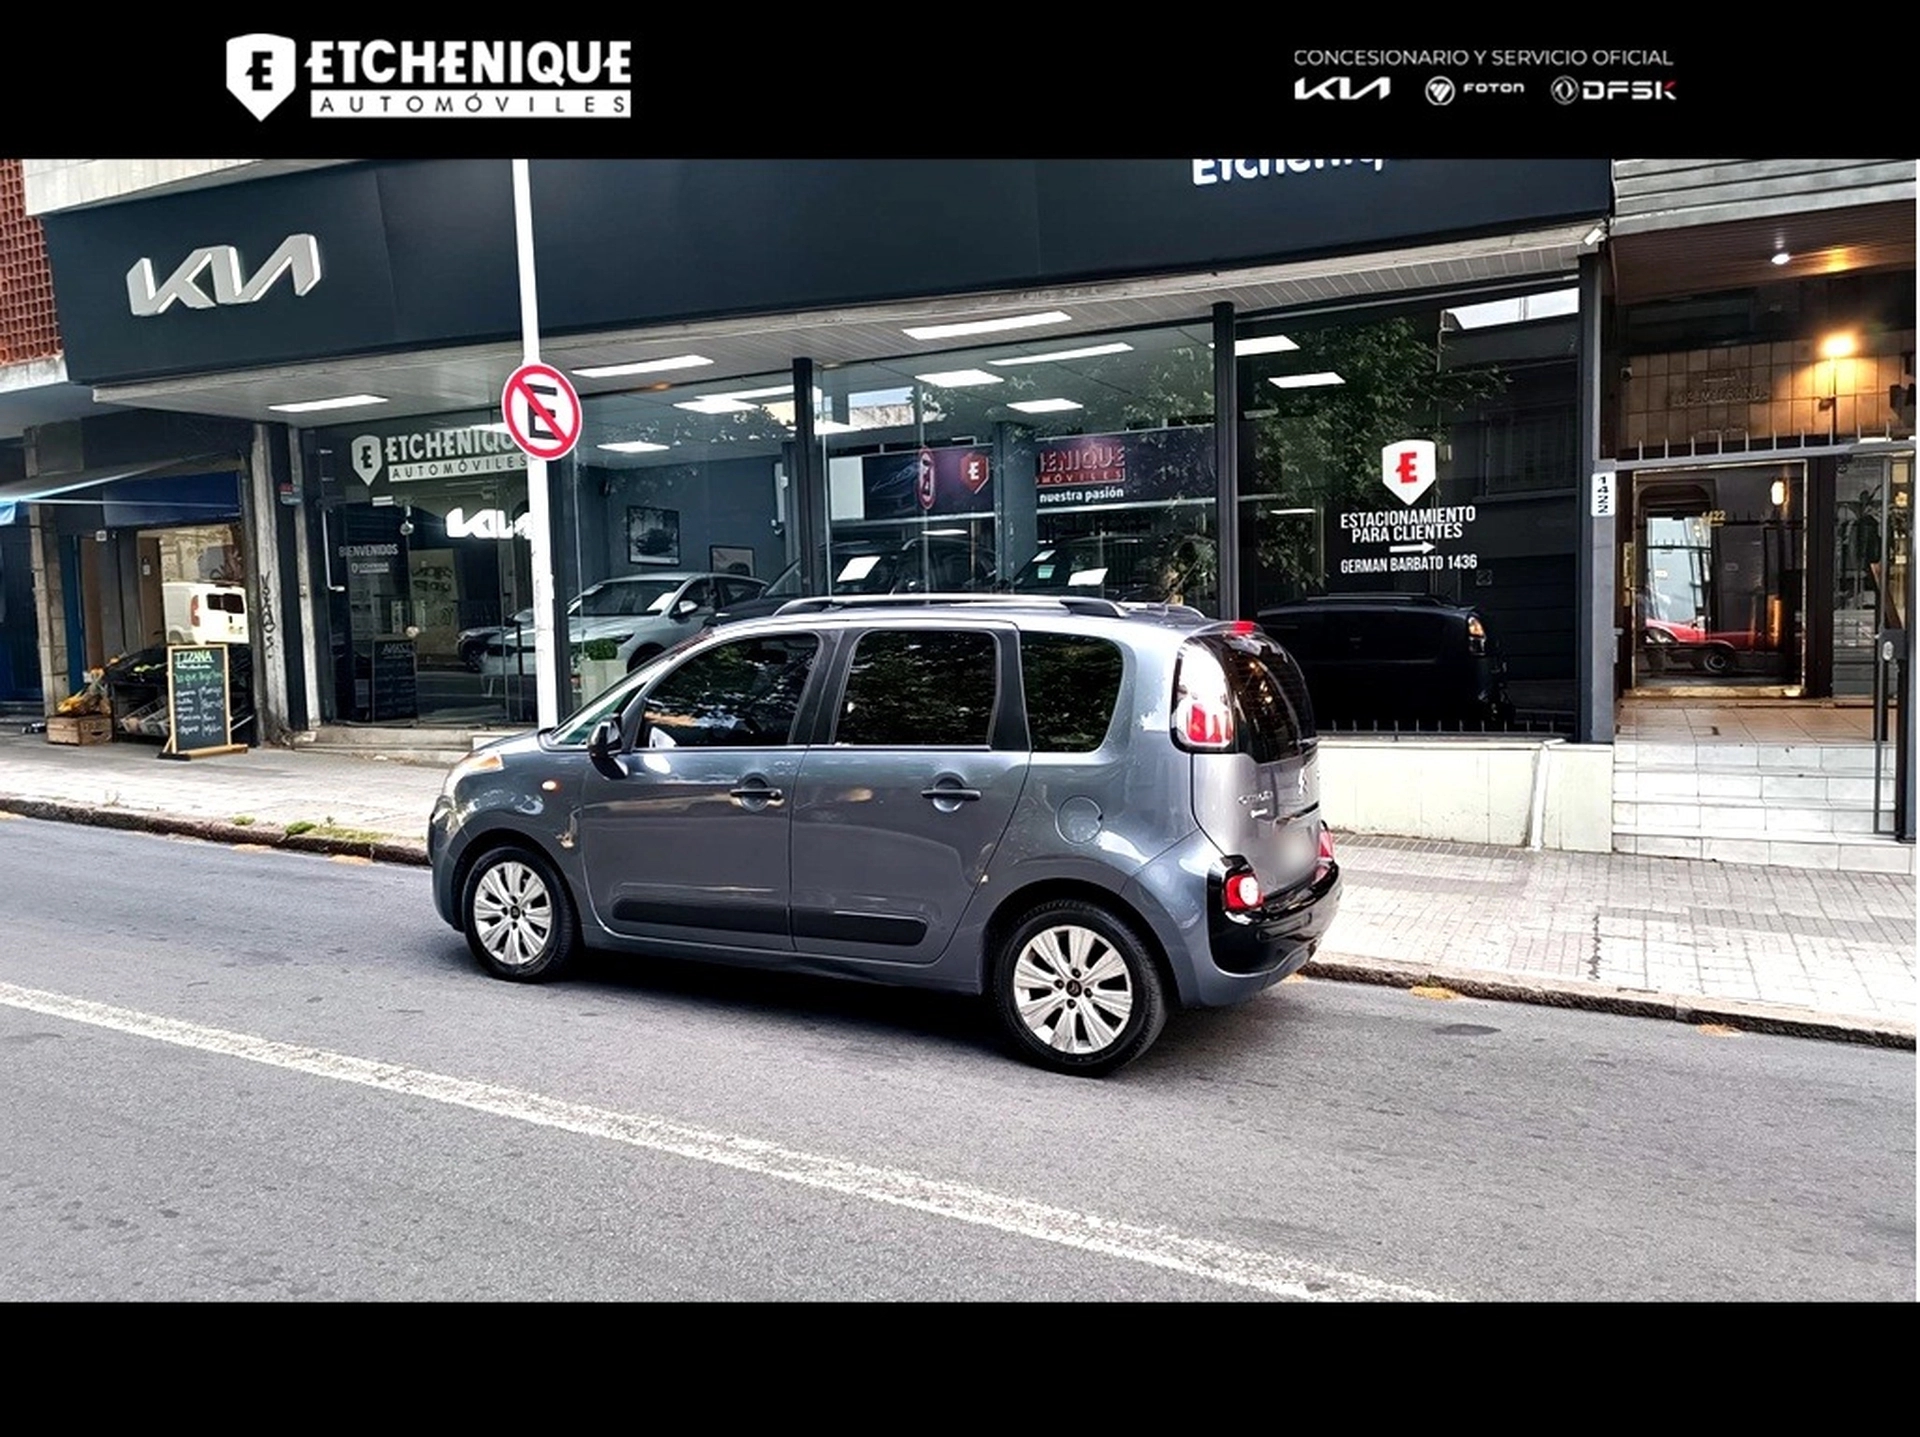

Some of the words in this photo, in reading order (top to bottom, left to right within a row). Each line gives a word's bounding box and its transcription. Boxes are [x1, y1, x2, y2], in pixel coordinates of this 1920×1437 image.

[126, 233, 321, 317] KIA
[392, 455, 528, 479] AUTOMÓVILES
[1039, 490, 1083, 504] nuestra
[1084, 486, 1125, 503] pasión
[1340, 505, 1476, 529] ESTACIONAMIENTO
[1352, 527, 1390, 543] PARA
[1393, 522, 1463, 541] CLIENTES
[338, 543, 399, 557] BIENVENIDOS
[1340, 558, 1388, 574] GERMAN
[1390, 555, 1444, 572] BARBATO
[1447, 554, 1478, 570] 1436
